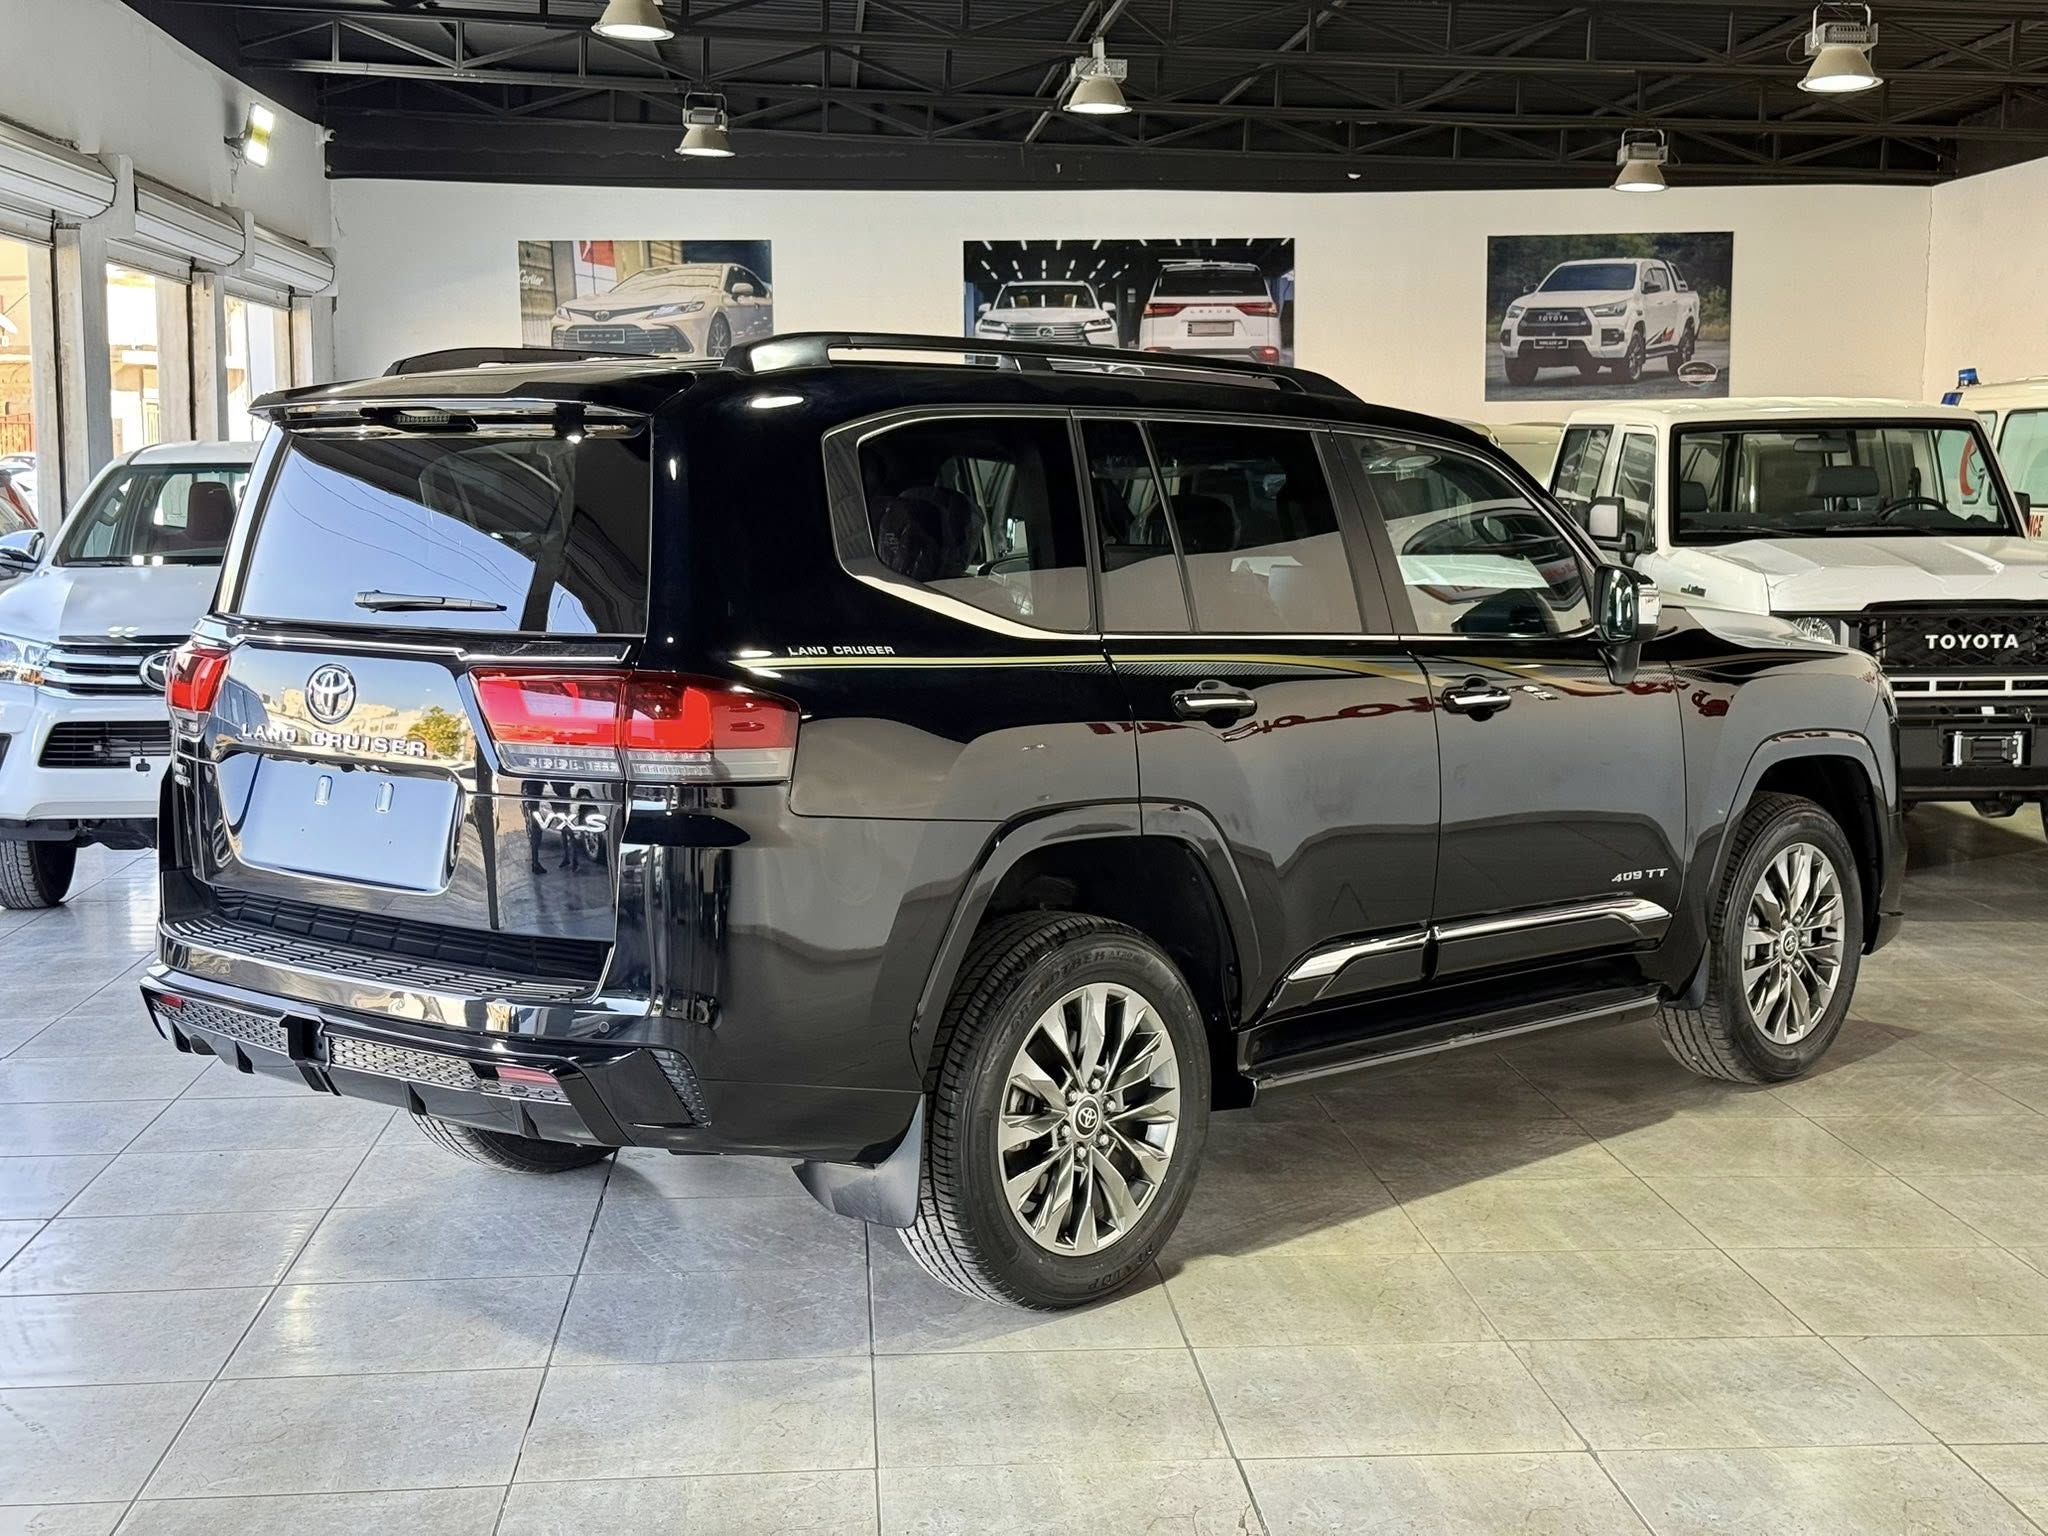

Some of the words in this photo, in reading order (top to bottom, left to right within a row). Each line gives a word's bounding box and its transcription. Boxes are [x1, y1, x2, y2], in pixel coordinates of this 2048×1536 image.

[1925, 633, 2019, 650] TOYOTA
[787, 646, 828, 656] LAND
[832, 645, 896, 655] CRUISER
[241, 723, 298, 743] LAND
[311, 730, 428, 758] CRUISER
[1611, 870, 1643, 883] 409
[1645, 867, 1669, 878] TT
